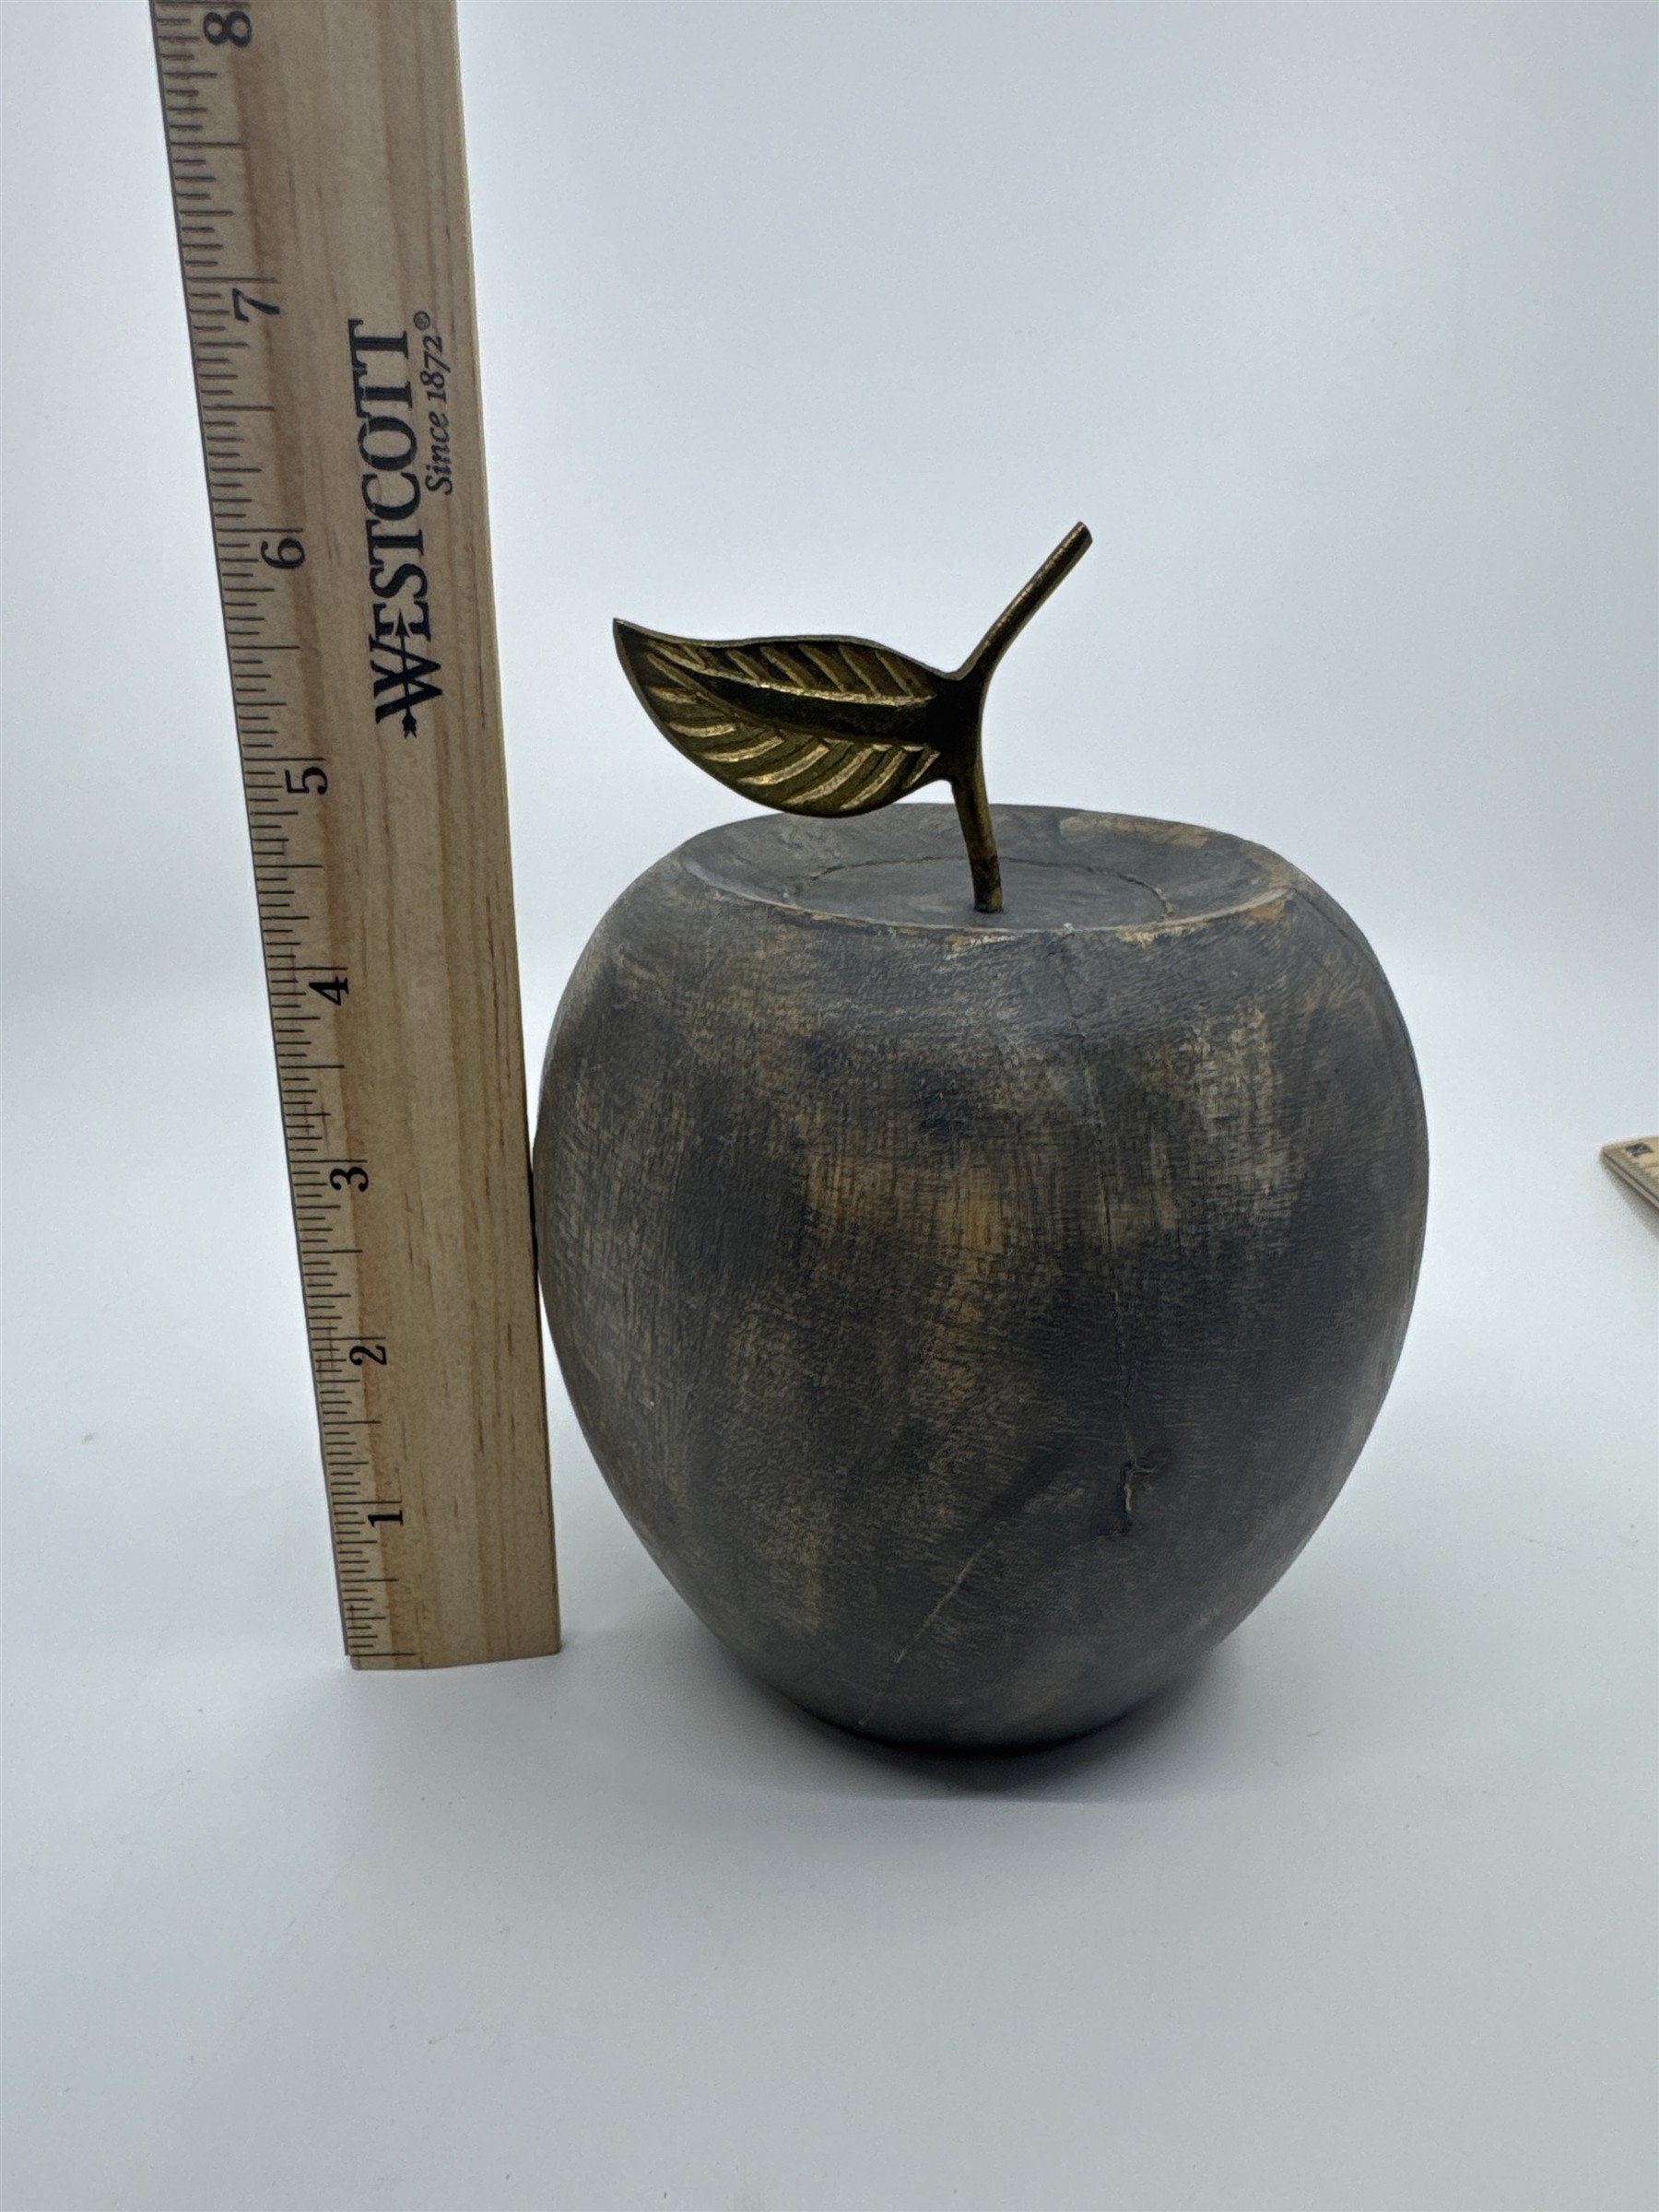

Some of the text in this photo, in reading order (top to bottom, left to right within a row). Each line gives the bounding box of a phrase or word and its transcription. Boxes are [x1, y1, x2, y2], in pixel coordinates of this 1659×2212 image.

[202, 10, 253, 47] 8
[231, 287, 281, 324] 7
[424, 411, 453, 496] Since
[347, 317, 443, 725] WESTCOTT
[260, 536, 306, 571] 6
[284, 766, 329, 795] 5
[308, 976, 350, 1006] 4
[329, 1166, 369, 1192] 3
[348, 1344, 388, 1367] 2
[367, 1509, 405, 1527] 1
